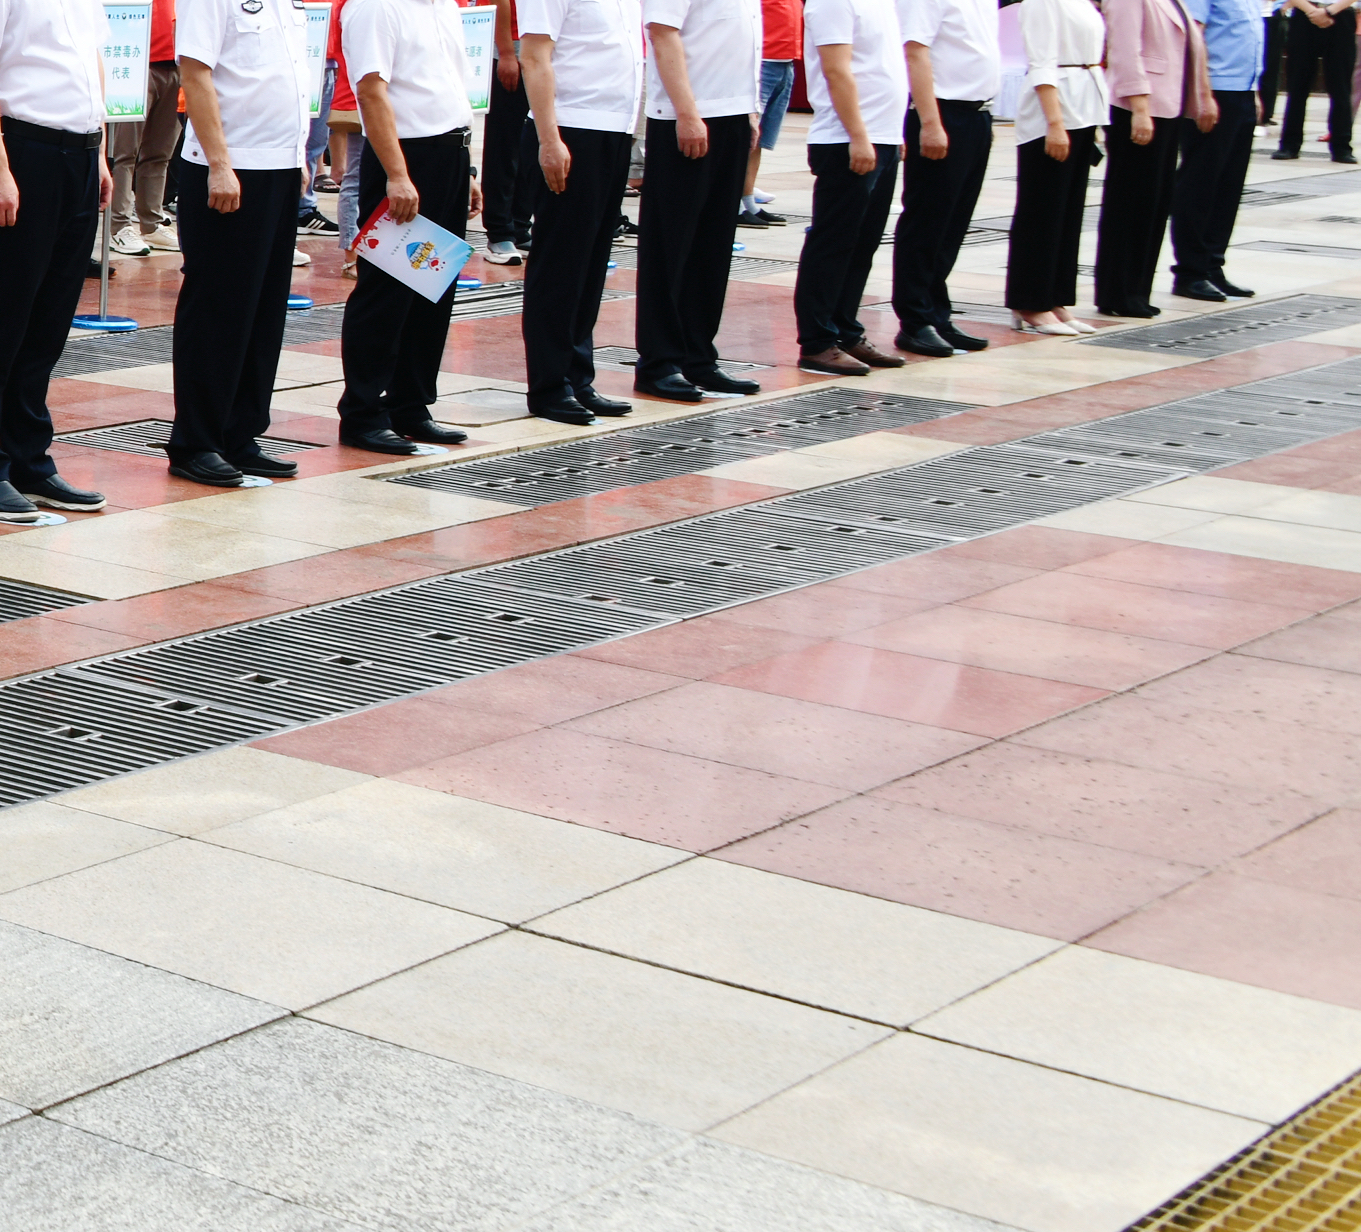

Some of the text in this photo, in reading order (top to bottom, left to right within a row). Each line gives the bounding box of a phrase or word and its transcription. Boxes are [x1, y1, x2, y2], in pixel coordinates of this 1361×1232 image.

[104, 45, 141, 59] 市禁毒办
[112, 67, 130, 80] 代表
